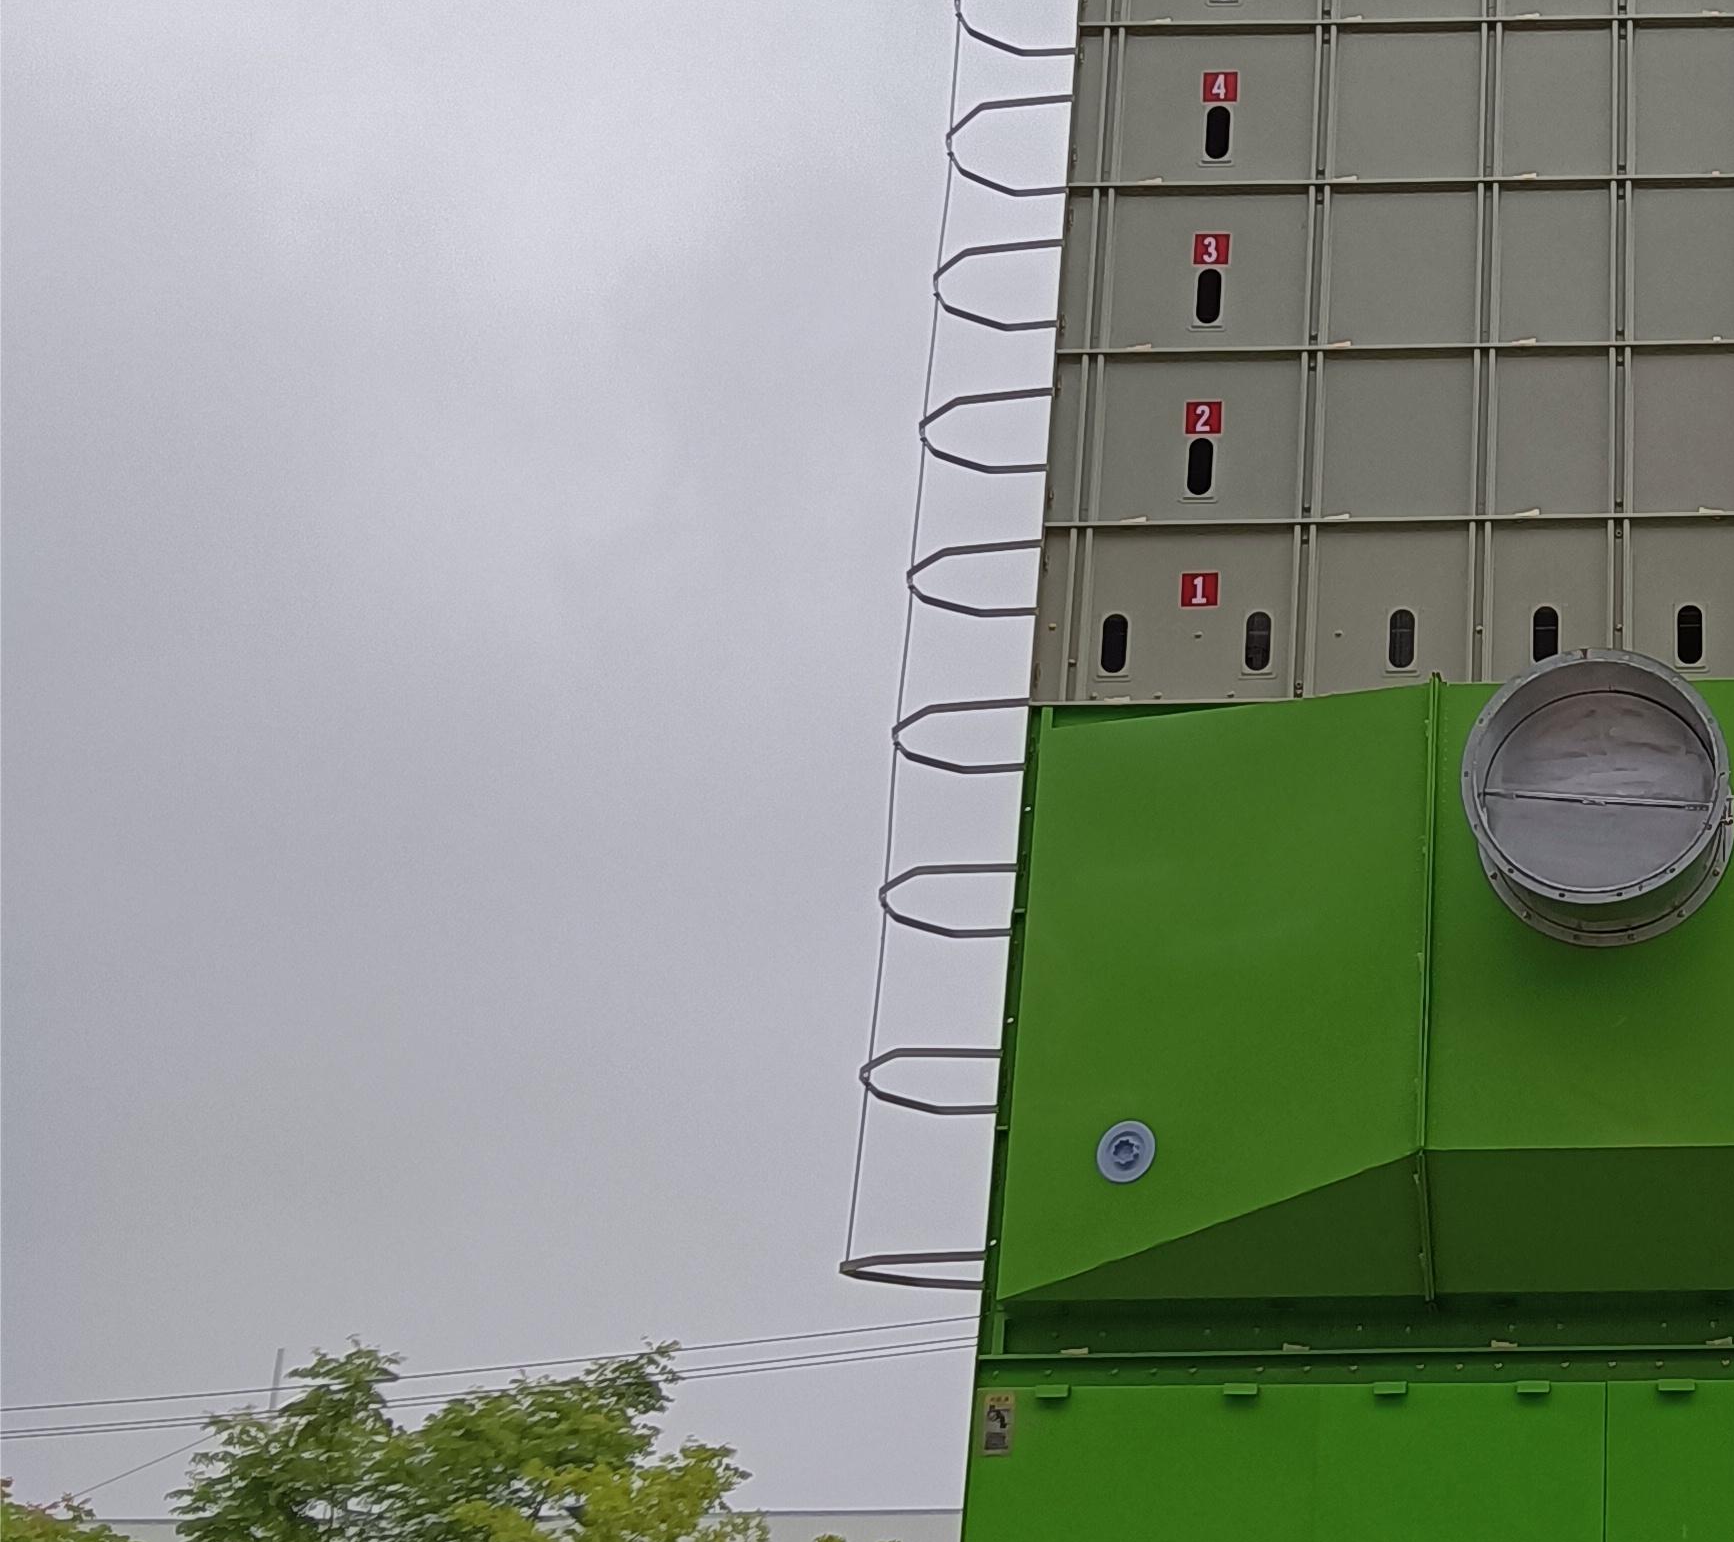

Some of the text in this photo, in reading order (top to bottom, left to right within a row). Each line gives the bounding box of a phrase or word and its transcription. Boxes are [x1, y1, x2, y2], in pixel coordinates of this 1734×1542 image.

[1211, 73, 1228, 100] 4
[1202, 235, 1219, 263] 3
[1194, 404, 1211, 433] 2
[1190, 575, 1208, 605] 1
